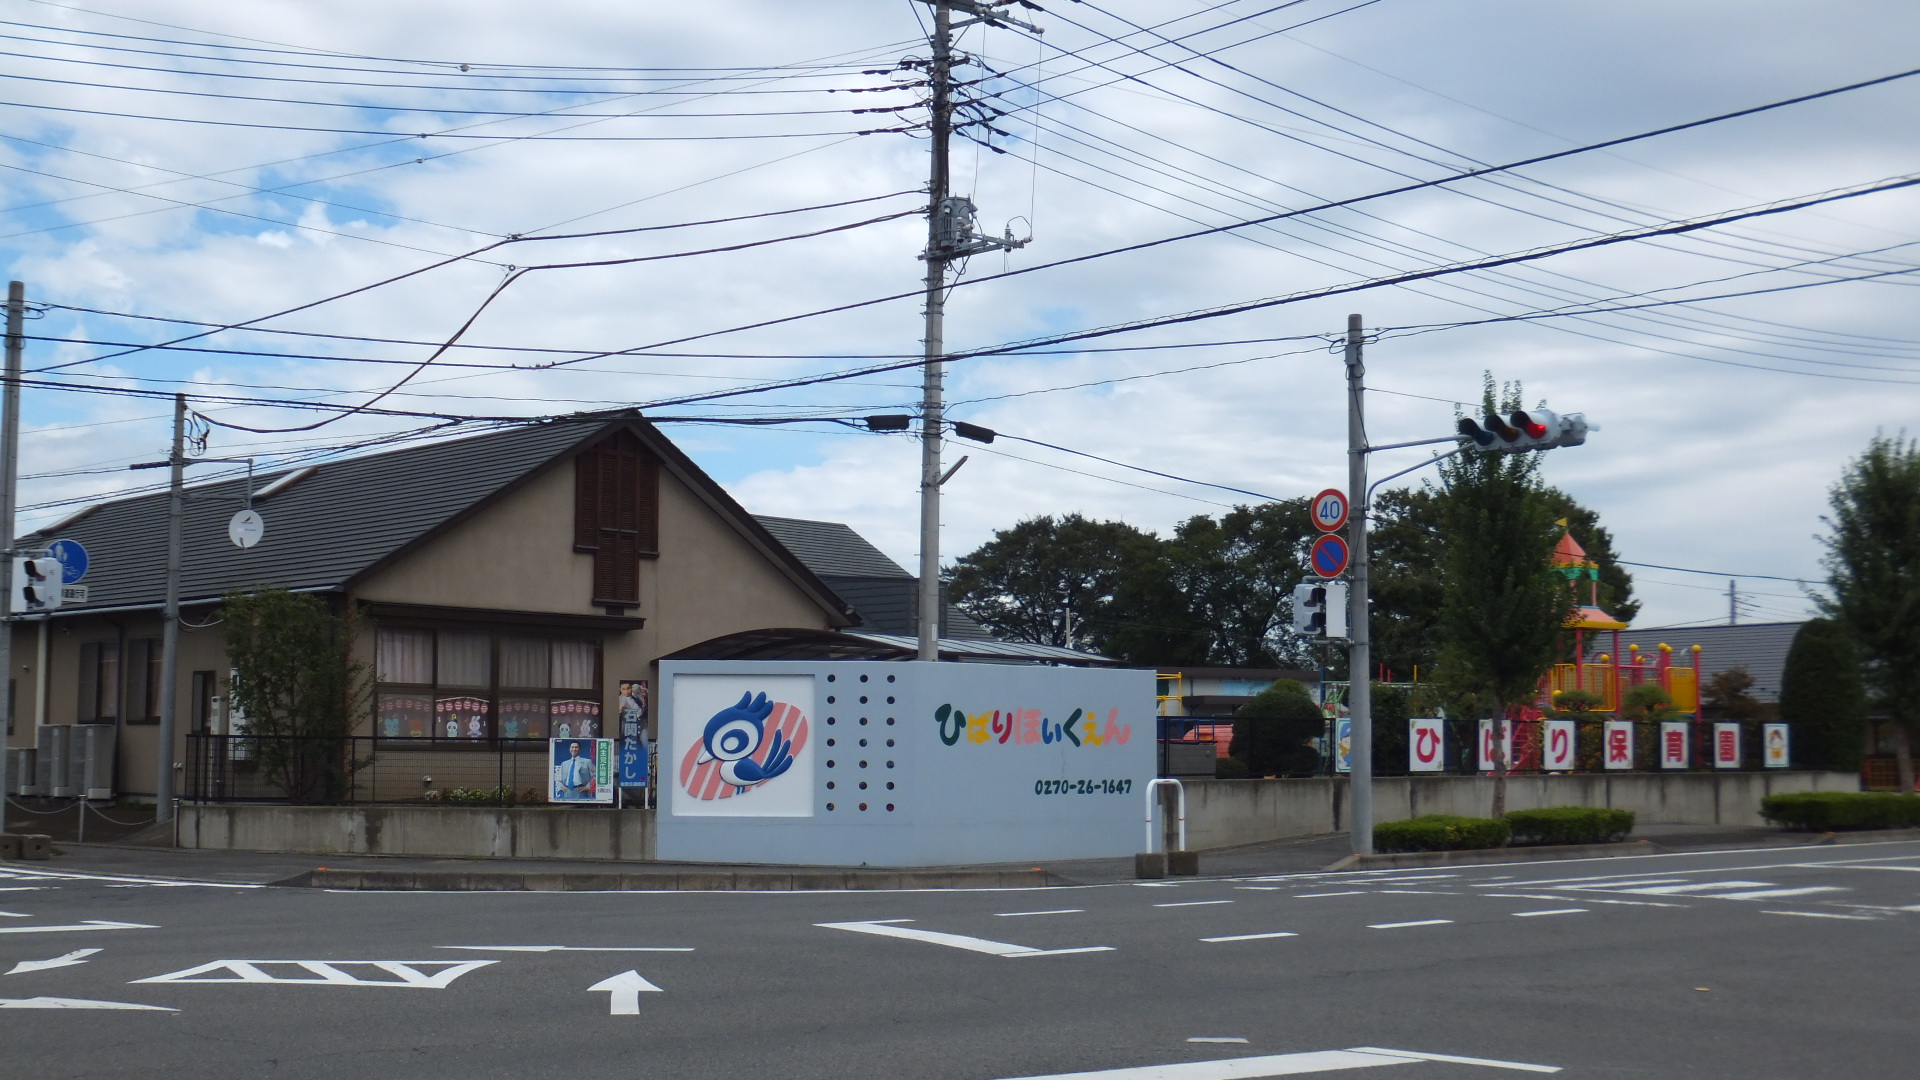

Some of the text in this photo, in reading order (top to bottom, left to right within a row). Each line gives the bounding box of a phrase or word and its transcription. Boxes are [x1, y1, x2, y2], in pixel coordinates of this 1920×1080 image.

[1320, 501, 1340, 519] 40
[934, 703, 1131, 747] ひばりほいくえん
[624, 709, 638, 779] 石関たかし
[1416, 728, 1440, 763] ひ
[1551, 728, 1568, 764] り
[1608, 729, 1628, 763] 保
[1665, 730, 1684, 763] 育
[1719, 730, 1736, 762] 園
[1035, 779, 1132, 795] 0270-26-1647
